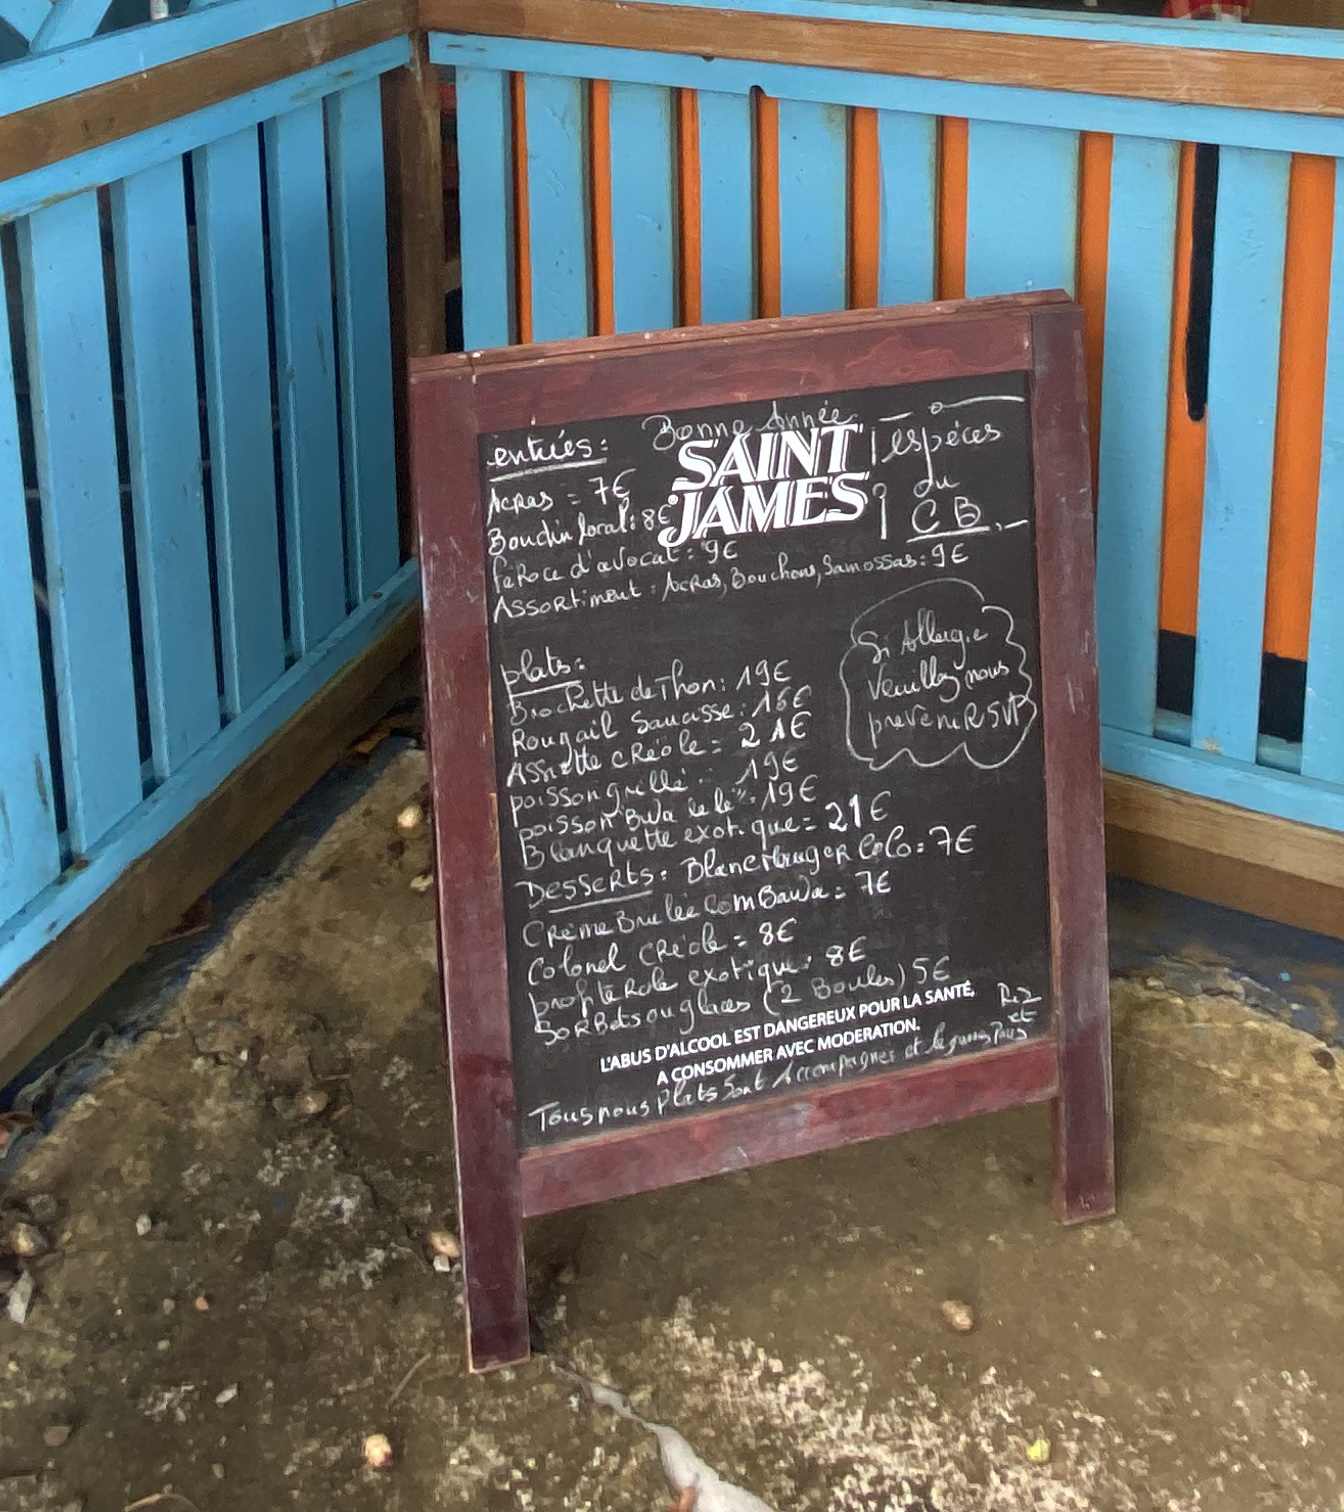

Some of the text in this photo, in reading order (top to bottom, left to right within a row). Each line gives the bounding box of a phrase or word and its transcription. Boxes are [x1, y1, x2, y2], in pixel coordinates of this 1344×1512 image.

[671, 423, 863, 492] SAINT
[657, 472, 870, 548] JAMES
[929, 825, 977, 856] 7€
[759, 917, 797, 946] 8€
[600, 1048, 652, 1073] L'ABUS
[655, 1032, 731, 1061] D'ALCOOL
[735, 1024, 762, 1044] EST
[764, 1006, 856, 1038] DANGEREUX
[859, 998, 901, 1019] POUR
[903, 993, 923, 1009] LA
[657, 1017, 921, 1086] A CONSOMMER AVEC MODERATION.
